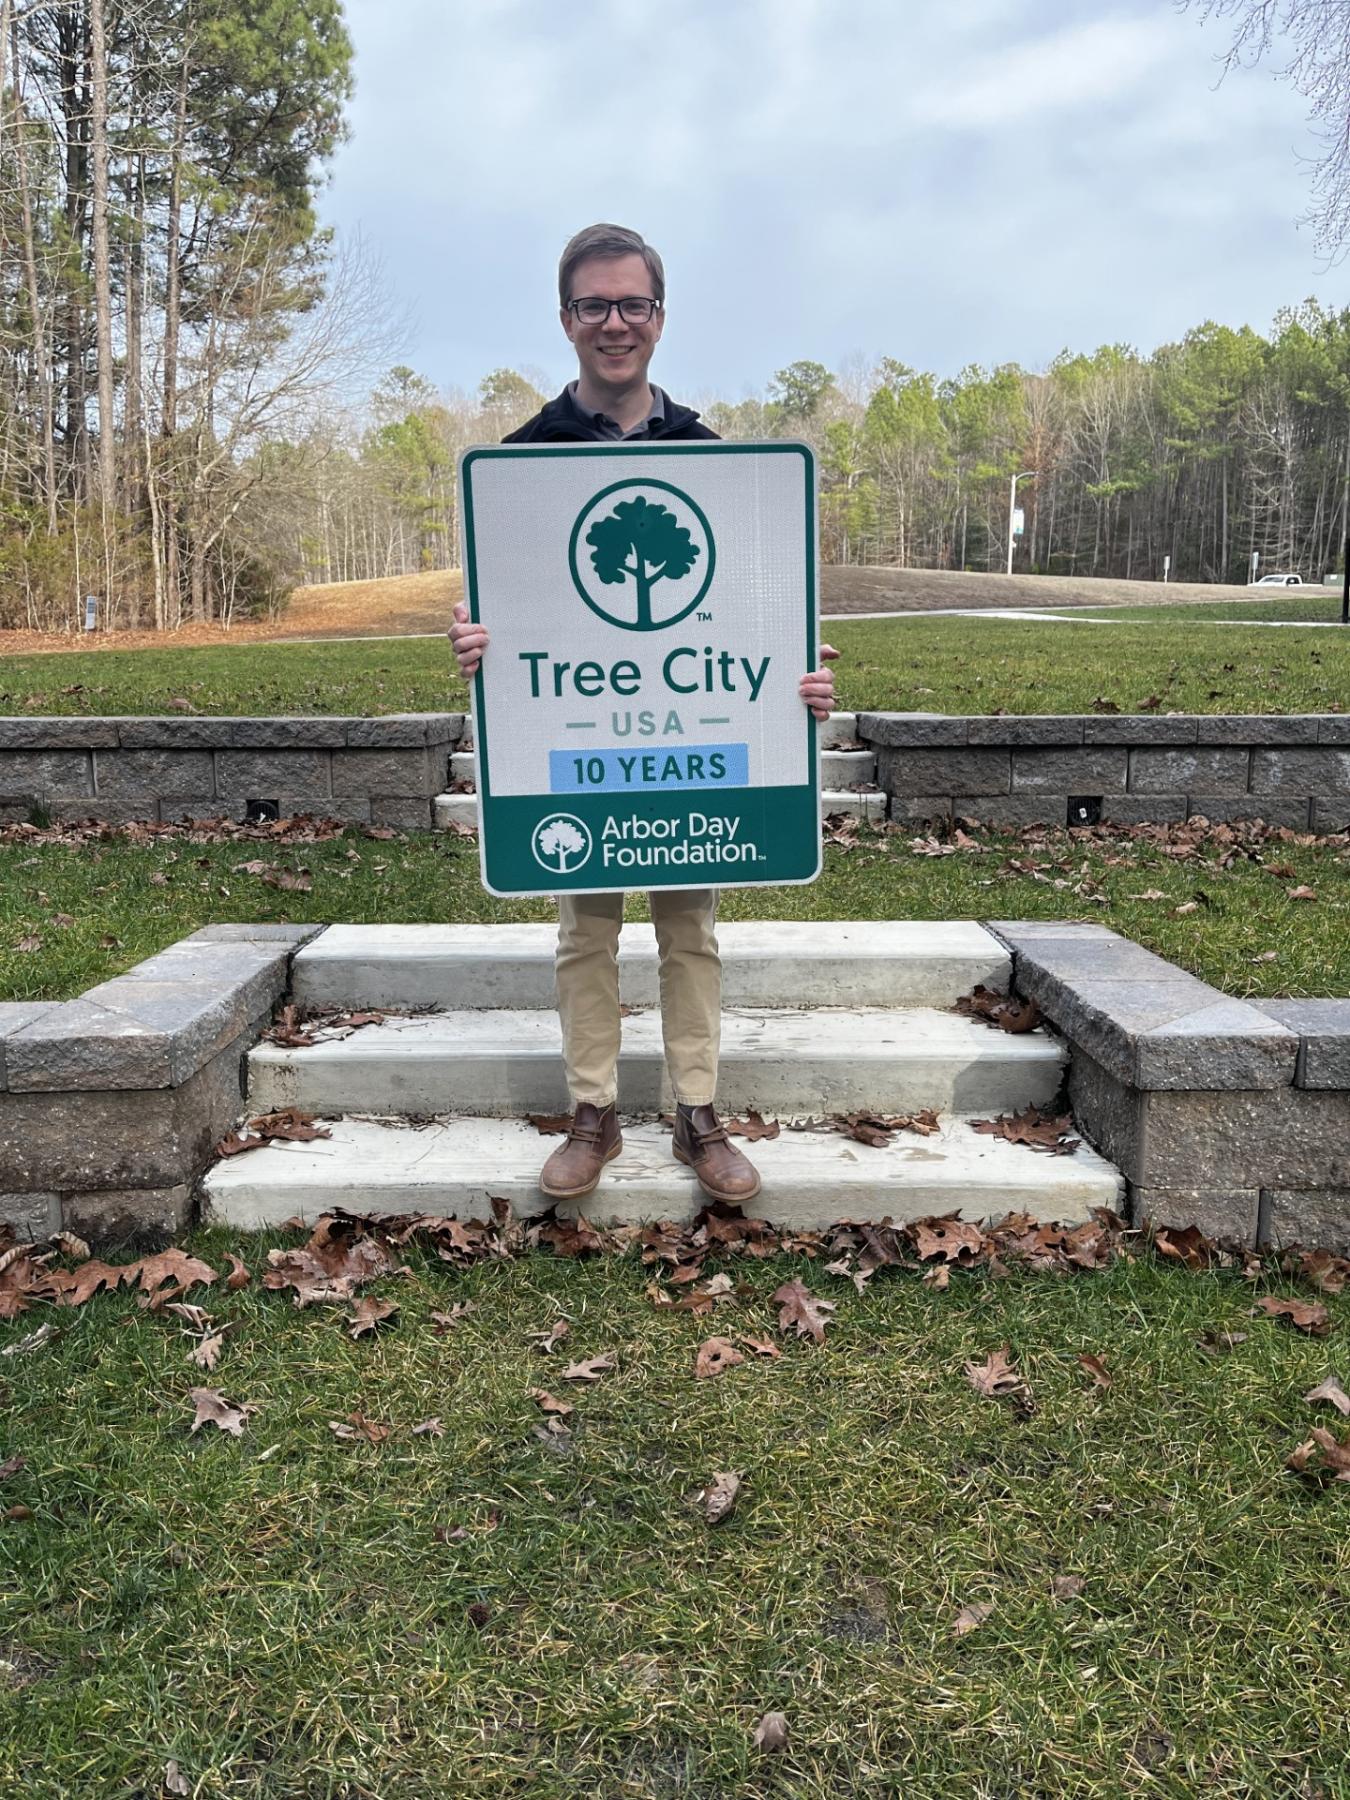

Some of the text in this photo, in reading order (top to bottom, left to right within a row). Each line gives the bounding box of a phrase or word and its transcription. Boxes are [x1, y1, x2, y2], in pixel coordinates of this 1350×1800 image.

[696, 612, 712, 621] TM
[518, 646, 771, 701] Tree City
[611, 709, 685, 737] USA
[573, 752, 727, 785] 10 YEARS
[601, 812, 740, 840] Arbor Day
[603, 838, 757, 867] Foundation
